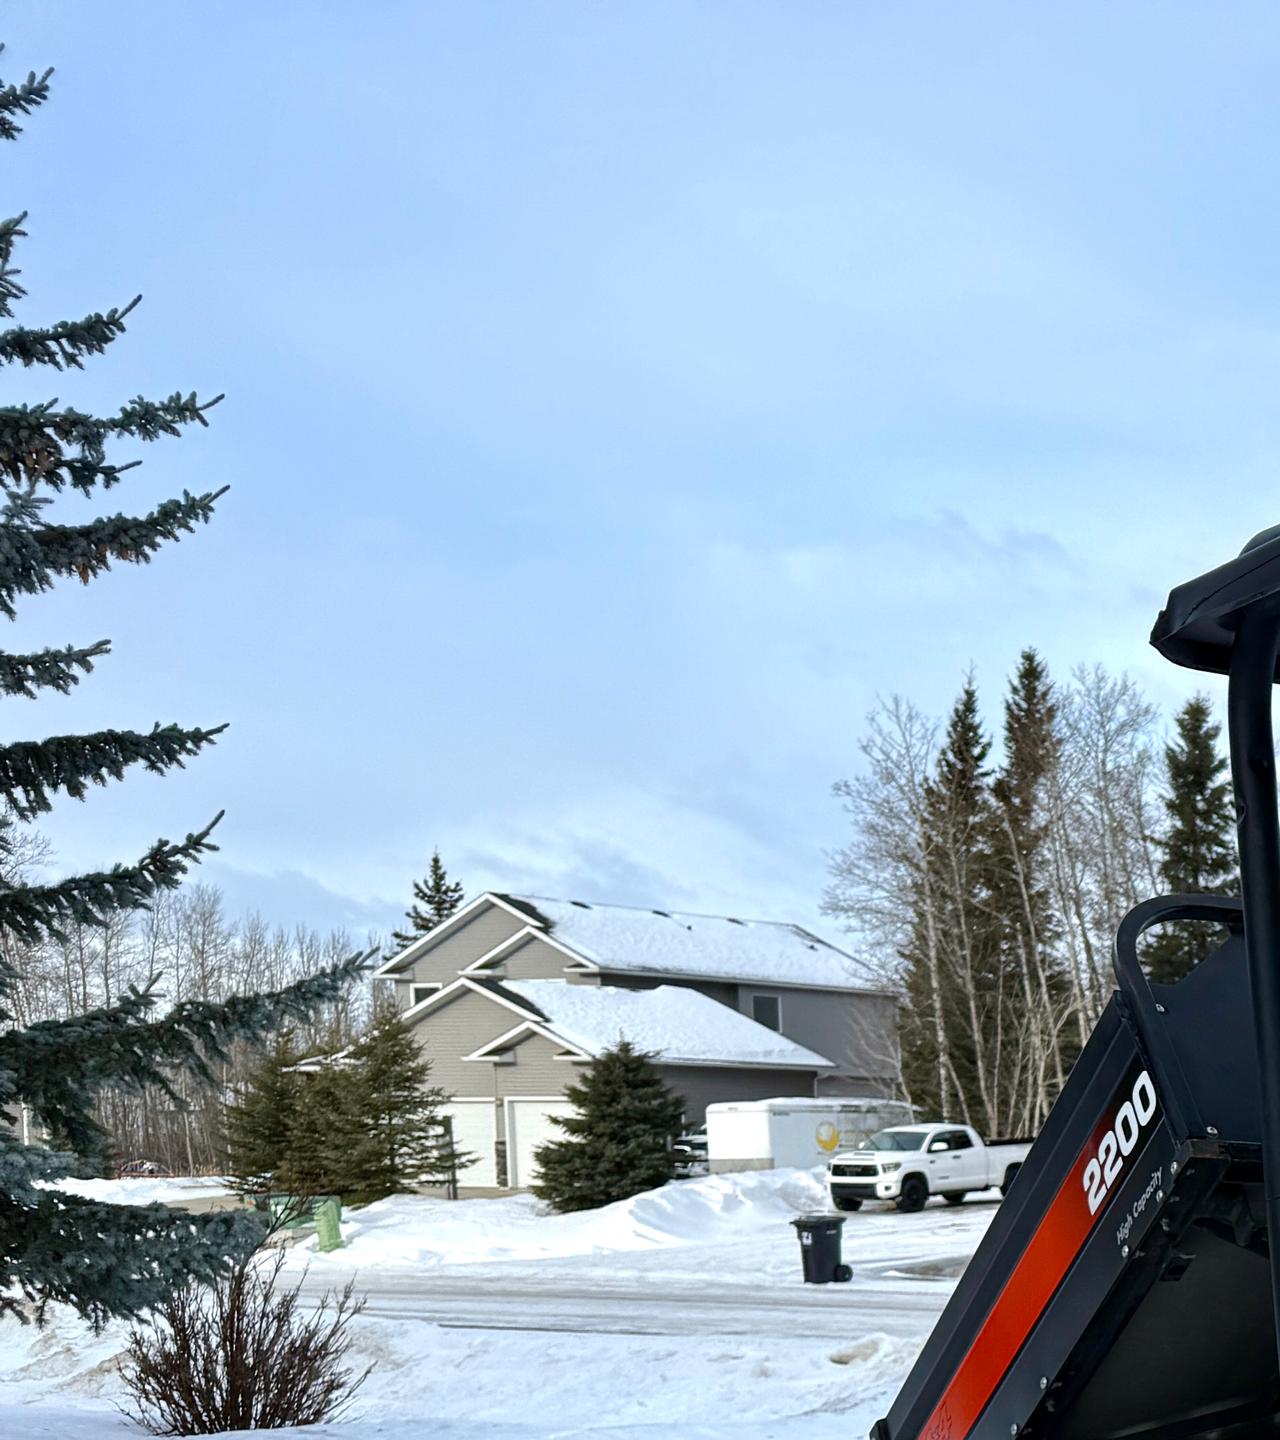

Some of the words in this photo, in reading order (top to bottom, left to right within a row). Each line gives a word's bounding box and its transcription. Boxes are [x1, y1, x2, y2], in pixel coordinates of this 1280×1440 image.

[1082, 1070, 1157, 1216] 2200
[1116, 1212, 1133, 1245] High
[1132, 1166, 1163, 1219] Capacity
